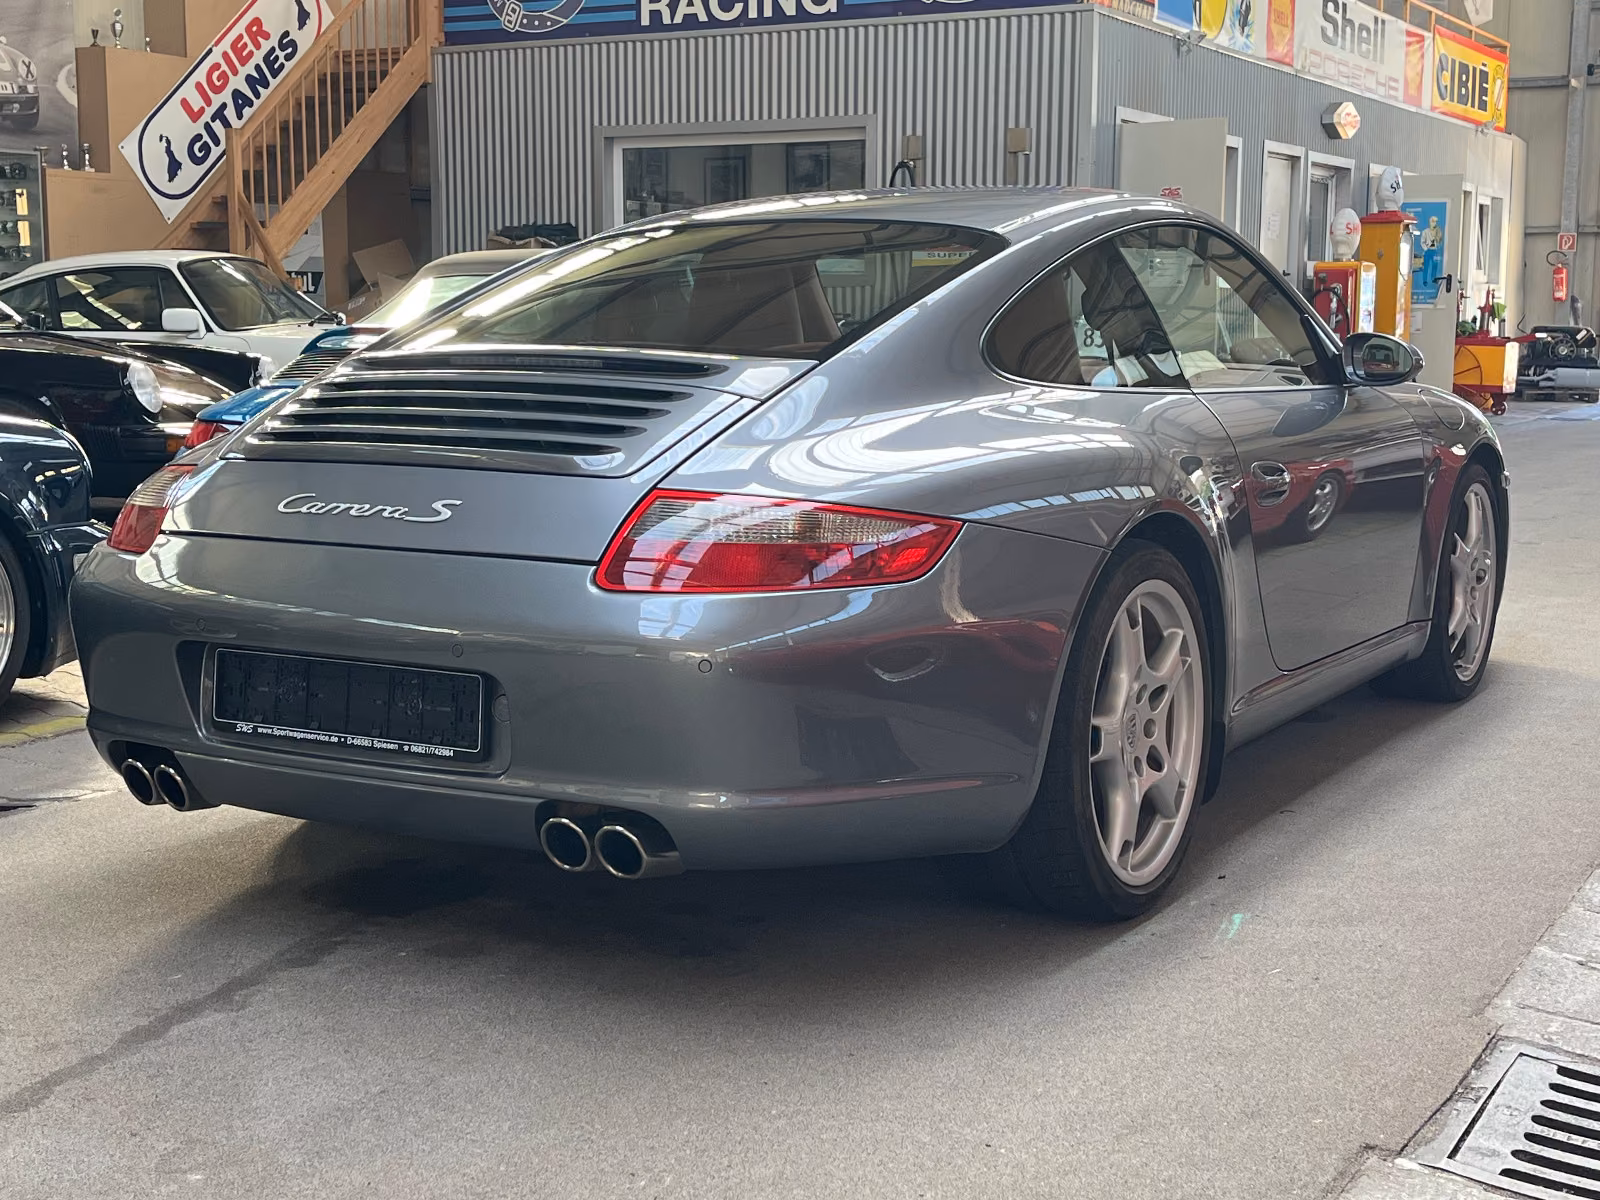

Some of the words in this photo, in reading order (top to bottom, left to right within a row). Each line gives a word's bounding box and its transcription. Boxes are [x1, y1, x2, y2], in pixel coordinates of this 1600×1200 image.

[1321, 0, 1386, 65] Shell
[180, 16, 271, 124] LIGIER
[186, 30, 298, 166] GITANES
[278, 493, 409, 518] Carrera
[403, 500, 463, 523] S
[236, 724, 253, 733] SWS
[257, 727, 338, 743] www.Sportwagenservice.de
[347, 736, 372, 747] D-66583
[373, 741, 399, 751] Spiesen
[410, 745, 454, 757] 06821/742984
